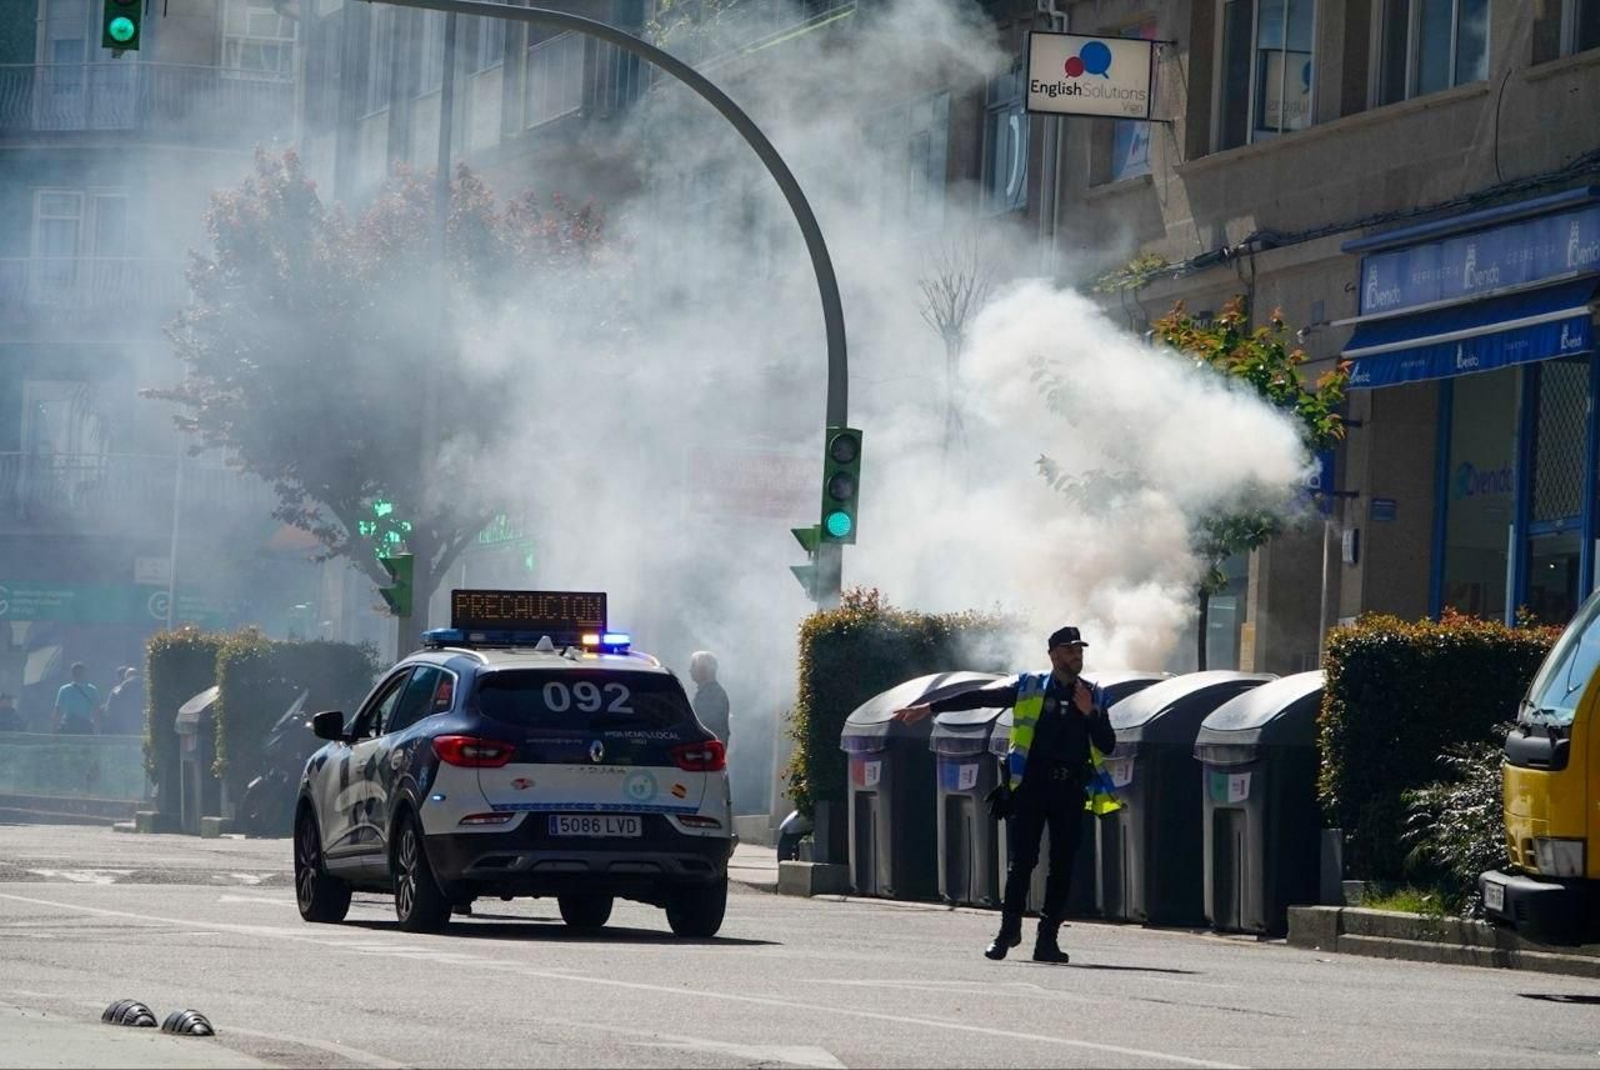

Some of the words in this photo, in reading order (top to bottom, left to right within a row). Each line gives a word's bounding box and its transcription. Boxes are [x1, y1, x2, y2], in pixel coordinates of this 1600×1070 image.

[1031, 80, 1146, 100] EnglishSolutions
[456, 594, 601, 619] PRECAUCION
[542, 681, 634, 714] 092
[560, 818, 601, 833] 5086
[606, 818, 637, 833] LVD
